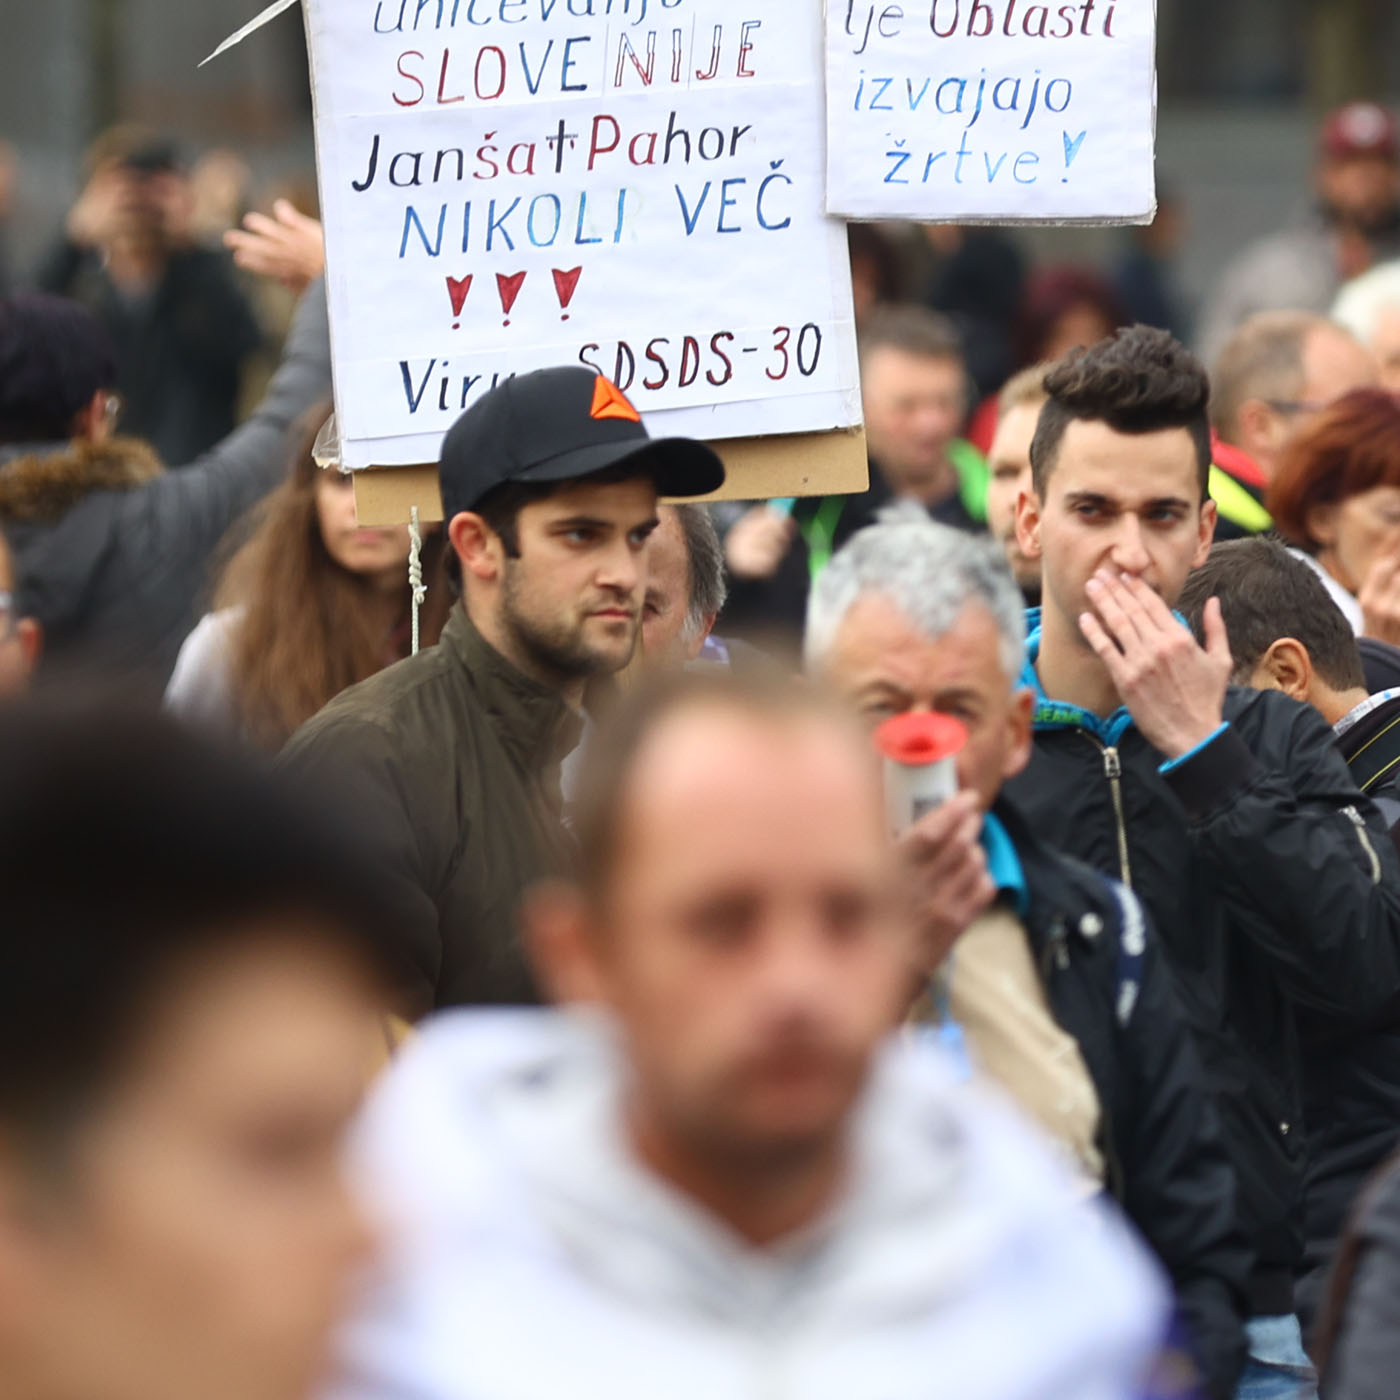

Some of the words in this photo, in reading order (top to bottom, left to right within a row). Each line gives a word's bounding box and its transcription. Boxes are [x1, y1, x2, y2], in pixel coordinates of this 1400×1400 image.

[391, 20, 762, 107] SLOVENIJE
[853, 67, 1074, 130] izvajajo
[398, 187, 627, 259] NIKOLI
[674, 158, 793, 237] VEČ
